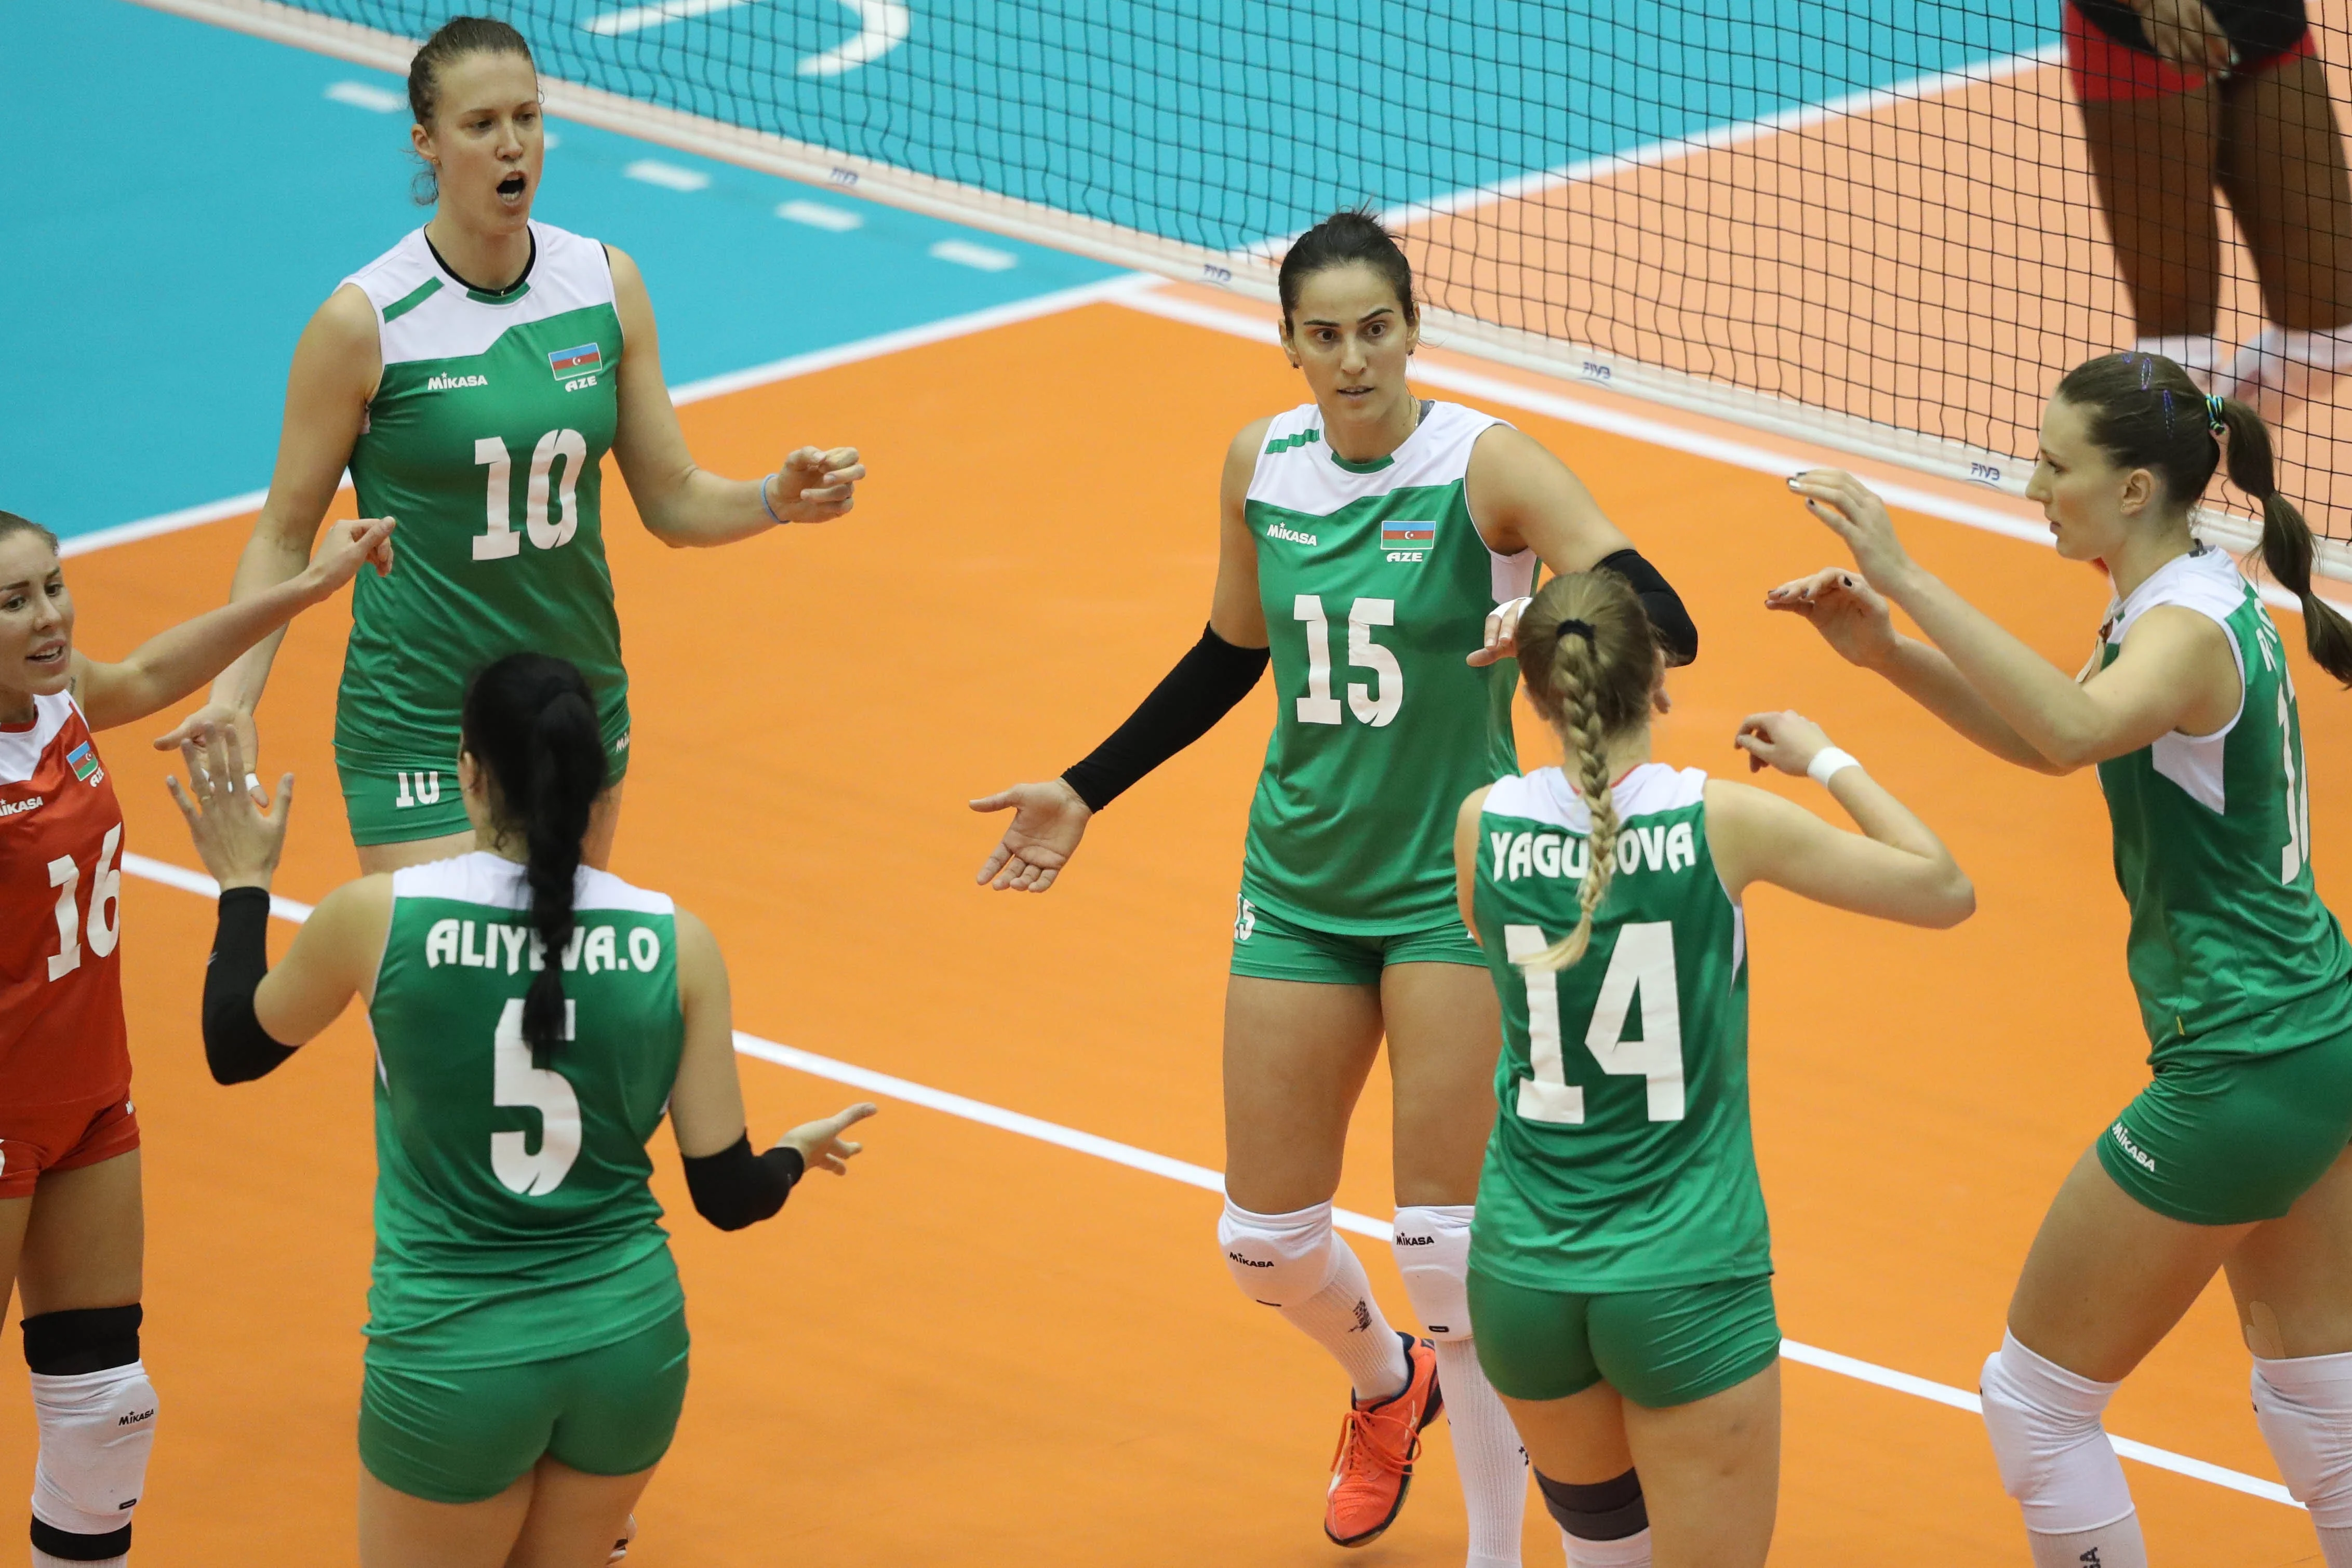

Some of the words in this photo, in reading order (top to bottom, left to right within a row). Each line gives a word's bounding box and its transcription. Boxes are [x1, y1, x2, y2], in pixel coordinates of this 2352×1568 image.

[427, 371, 488, 391] MiKASA
[565, 376, 597, 392] AZE
[472, 428, 586, 560] 10
[1266, 521, 1317, 546] MiKASA
[1386, 552, 1423, 562] AZE
[1293, 594, 1403, 727] 15
[1490, 822, 1696, 882] YAGUOVA
[47, 822, 122, 982] 16
[1504, 921, 1686, 1124] 14
[490, 998, 582, 1197] 5
